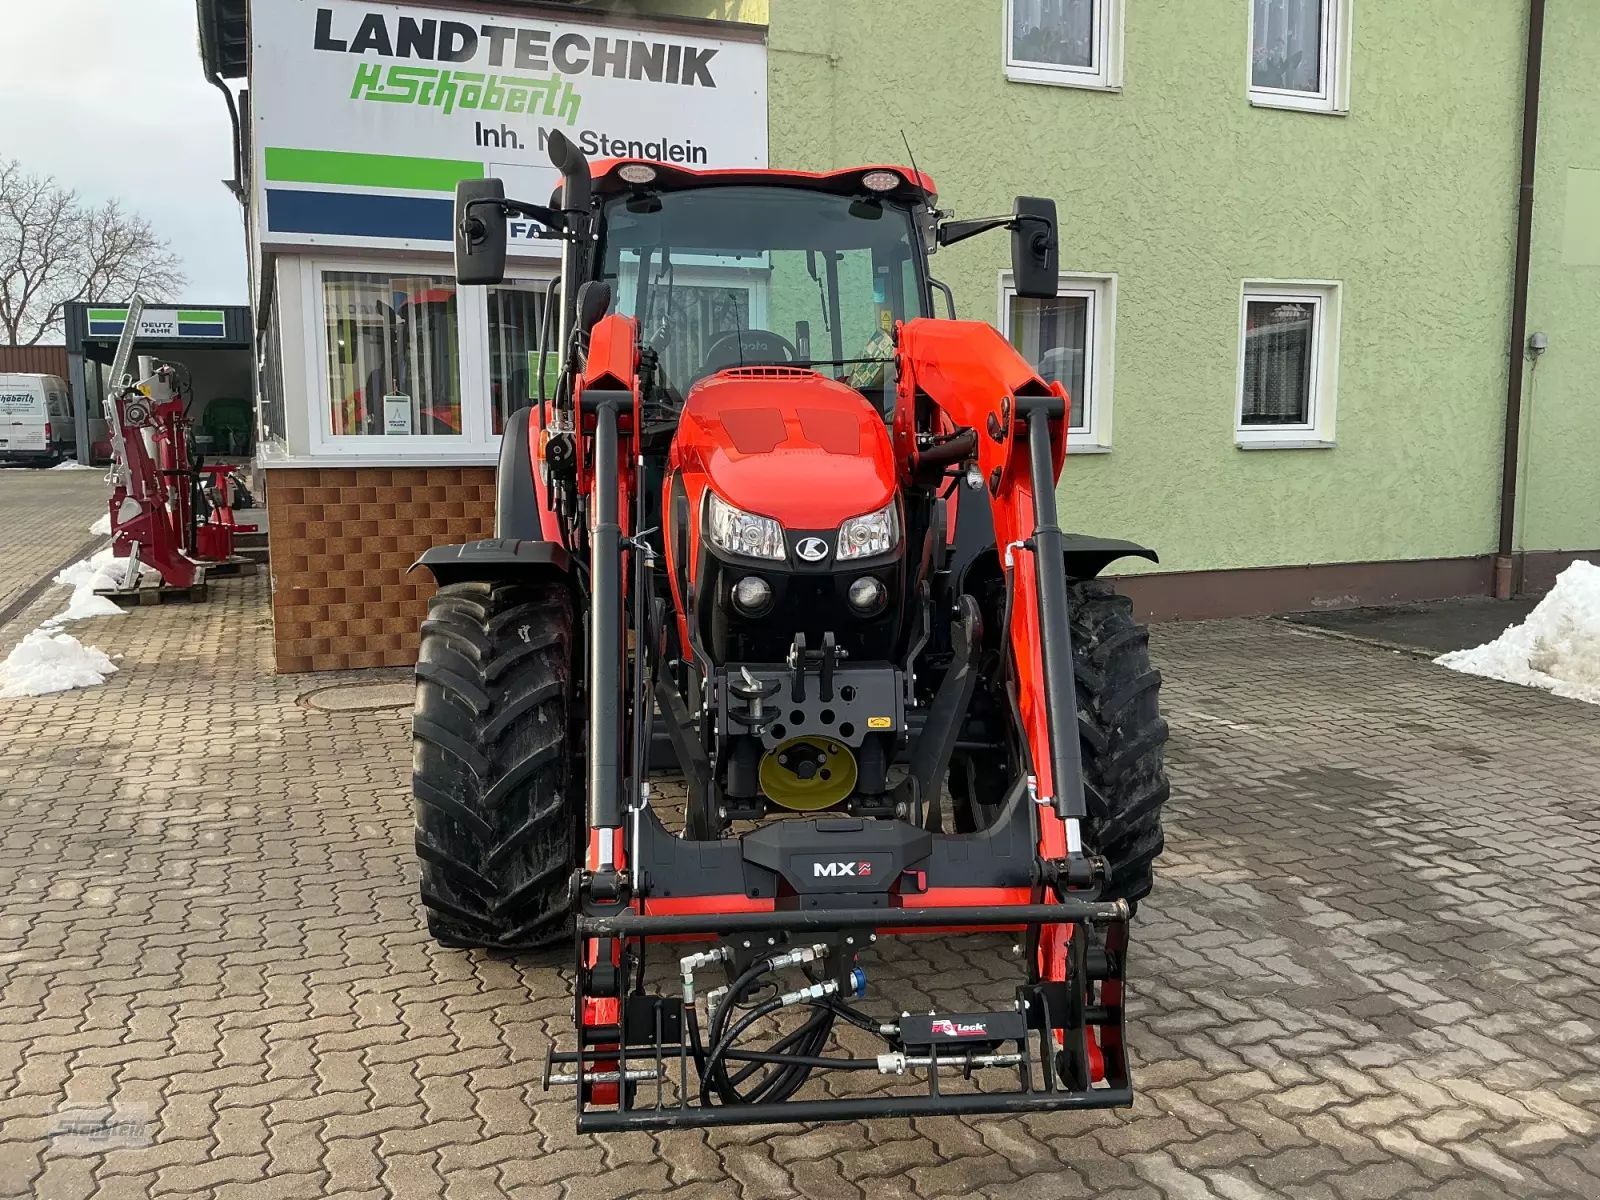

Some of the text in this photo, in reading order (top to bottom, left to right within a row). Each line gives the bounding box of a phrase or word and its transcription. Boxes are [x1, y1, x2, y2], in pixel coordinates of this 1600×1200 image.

[313, 8, 719, 89] LANDTECHNIK
[475, 121, 525, 150] Inh.
[579, 130, 707, 165] Stenglein
[813, 862, 856, 877] MX
